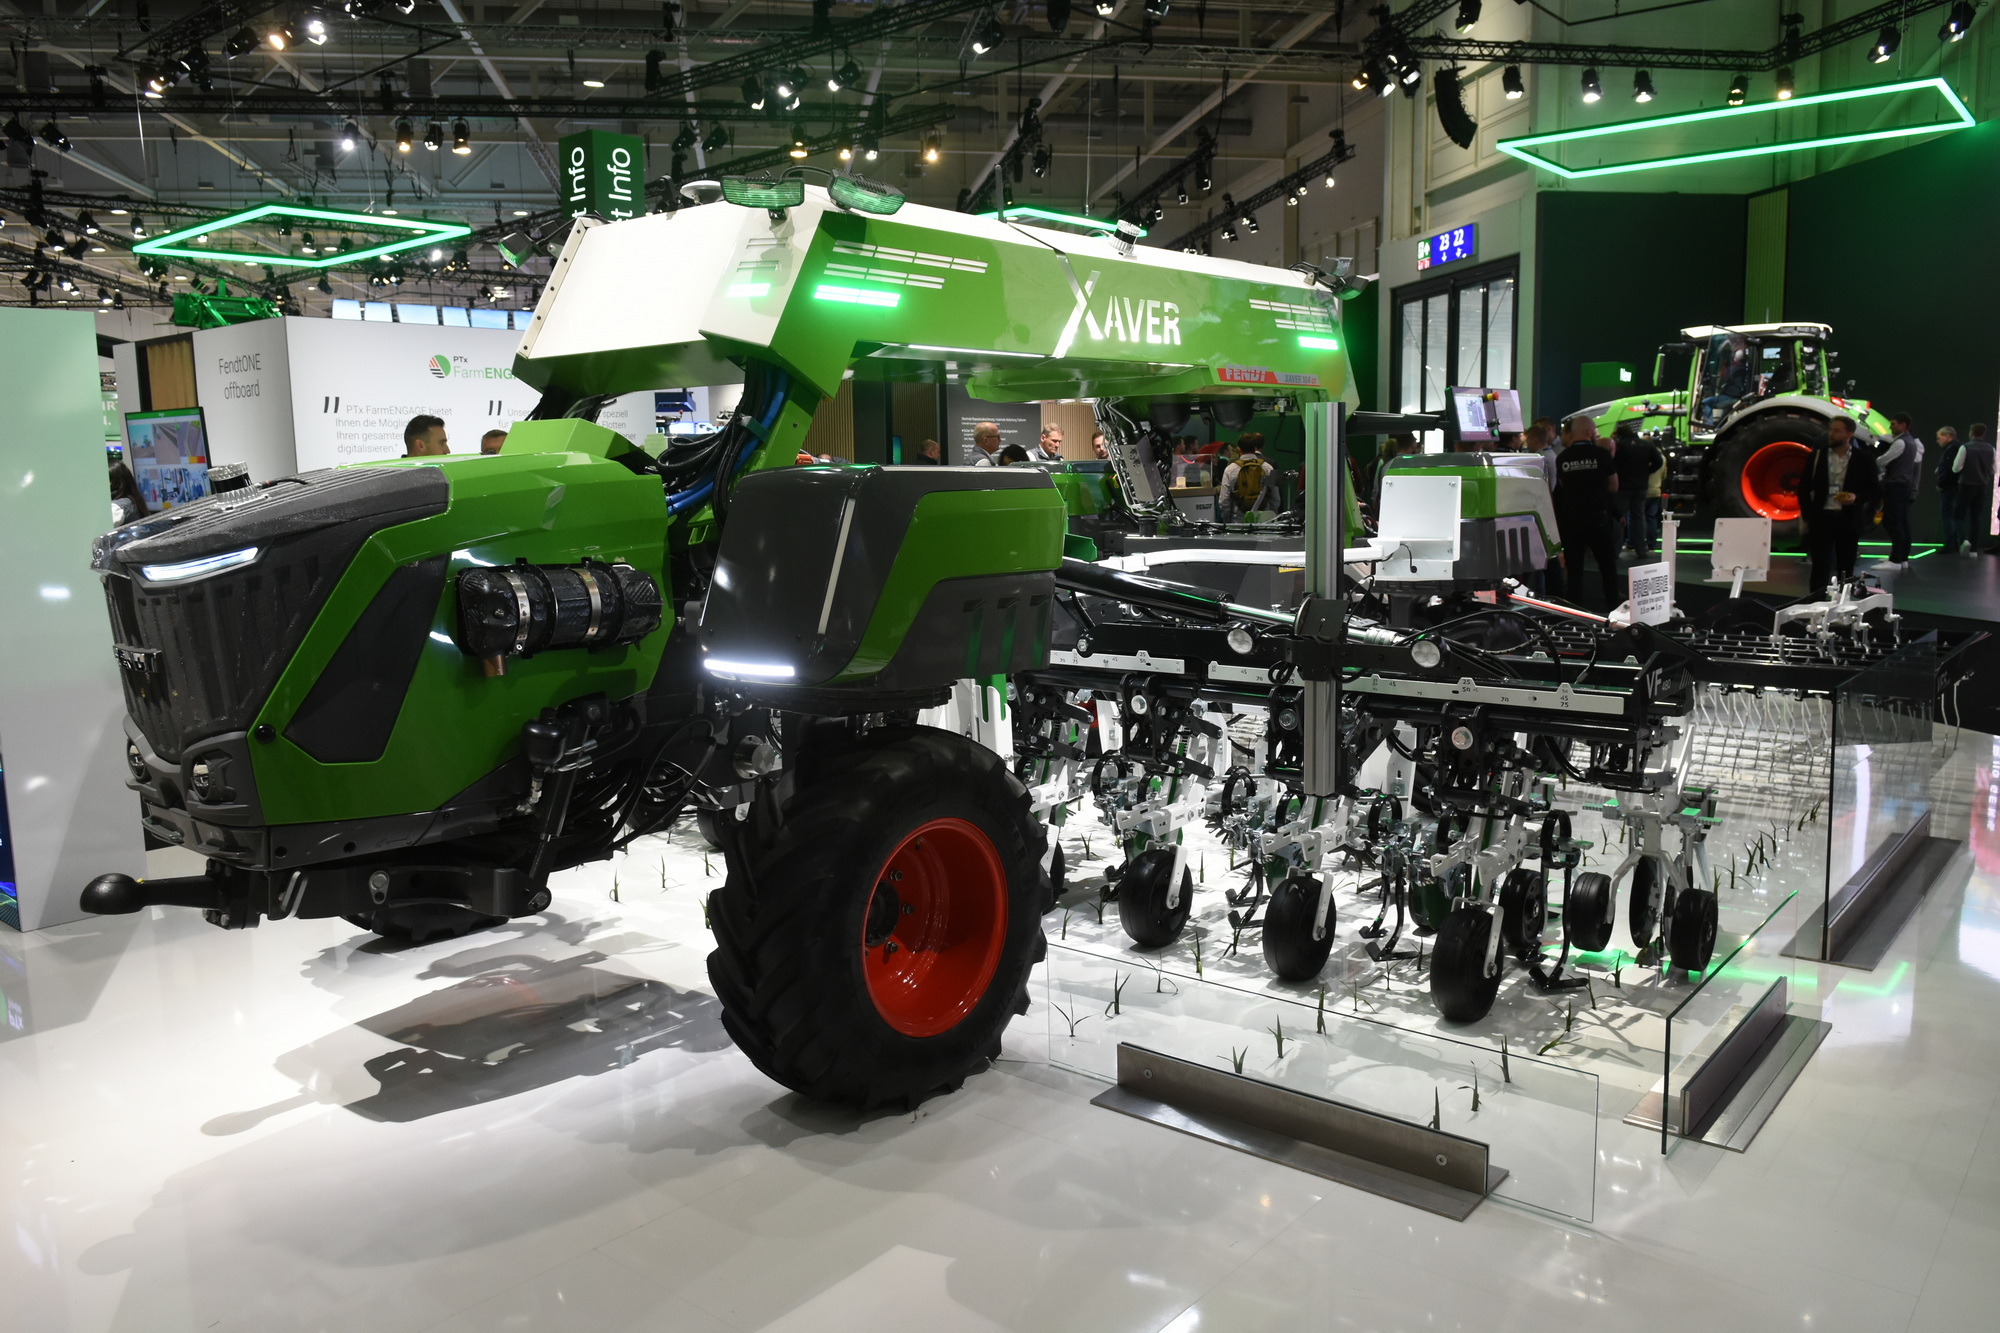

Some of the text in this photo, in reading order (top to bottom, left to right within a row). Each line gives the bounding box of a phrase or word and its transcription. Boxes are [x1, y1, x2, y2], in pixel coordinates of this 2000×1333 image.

[568, 147, 586, 202] Info
[607, 148, 632, 202] Info
[1439, 228, 1464, 251] 23 22
[1052, 256, 1181, 358] XAVER
[219, 353, 261, 376] FendtONE
[453, 356, 468, 364] PTx
[453, 366, 516, 380] FarmENG
[1225, 363, 1268, 382] FENDT
[224, 379, 260, 400] offboard
[346, 405, 364, 415] PTx
[429, 406, 453, 416] bietet
[336, 418, 364, 428] Ihnen
[364, 417, 376, 428] die
[337, 431, 360, 441] Ihren
[1646, 667, 1663, 699] VF
